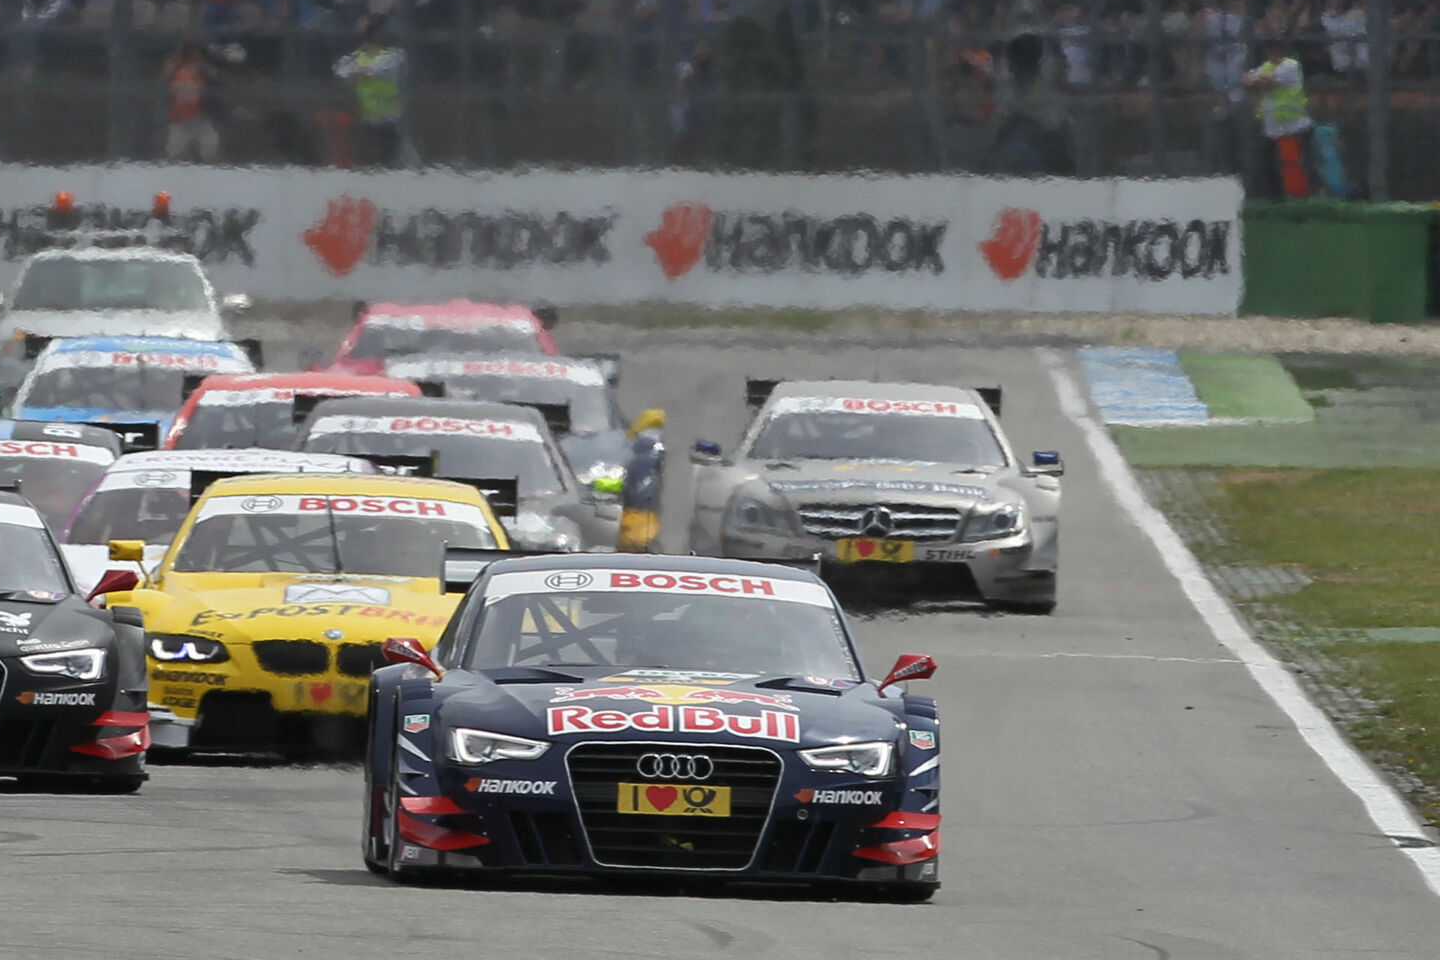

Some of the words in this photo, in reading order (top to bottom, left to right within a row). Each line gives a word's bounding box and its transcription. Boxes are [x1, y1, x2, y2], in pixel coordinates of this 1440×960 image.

[843, 398, 957, 414] BOSCH
[390, 417, 512, 436] BOSCH
[299, 496, 446, 517] BOSCH
[925, 549, 977, 561] STIHL
[610, 571, 774, 597] BOSCH
[548, 705, 673, 734] Red
[679, 705, 799, 743] Bull
